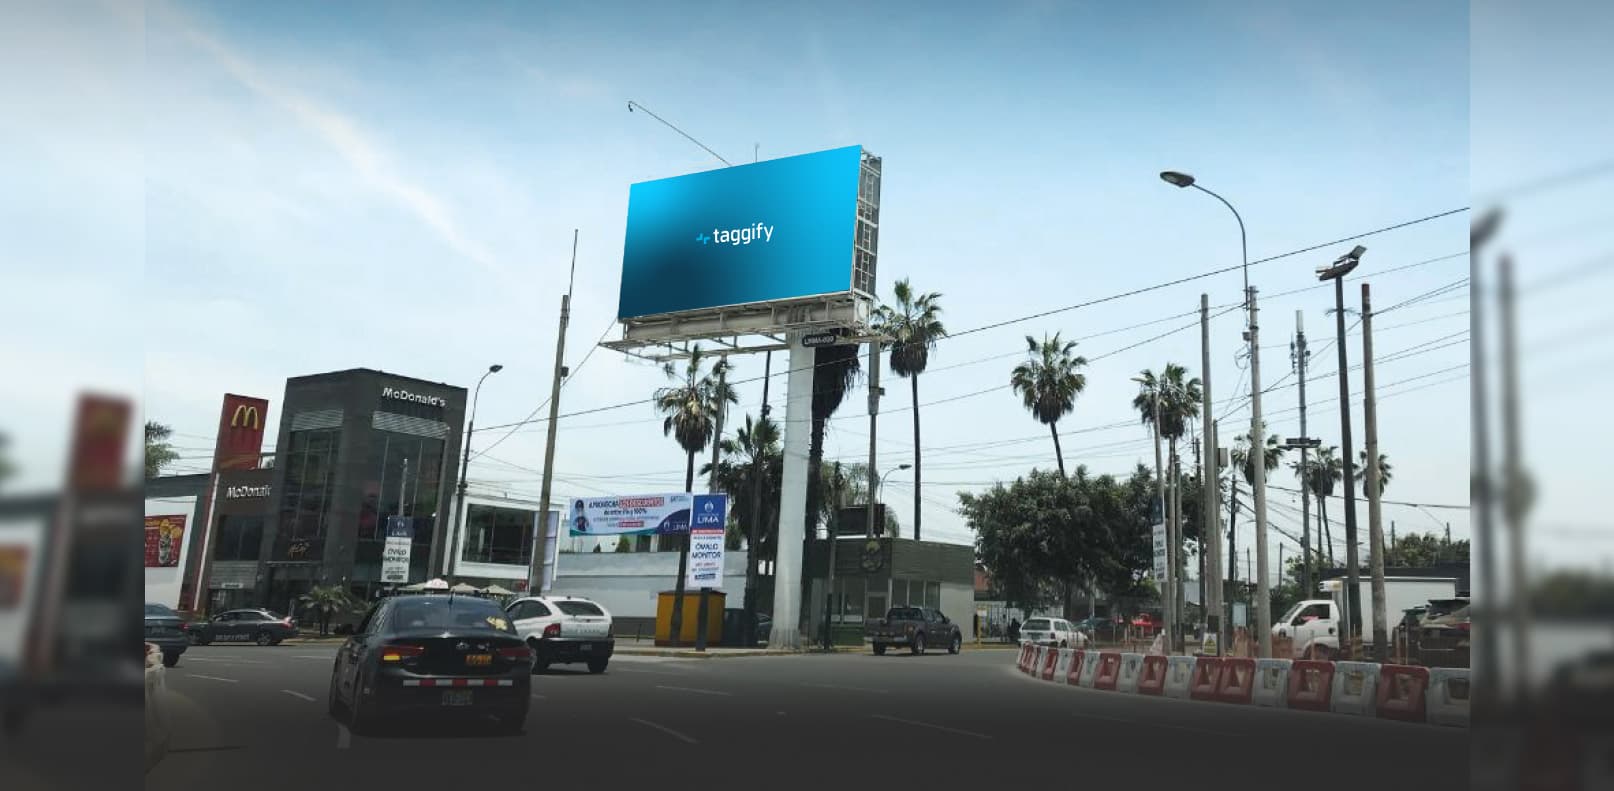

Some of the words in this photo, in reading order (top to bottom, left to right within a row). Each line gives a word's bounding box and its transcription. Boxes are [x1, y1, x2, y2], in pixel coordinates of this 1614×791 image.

[713, 222, 774, 246] taggify
[381, 387, 447, 408] McDonald's
[697, 515, 720, 524] LIMA
